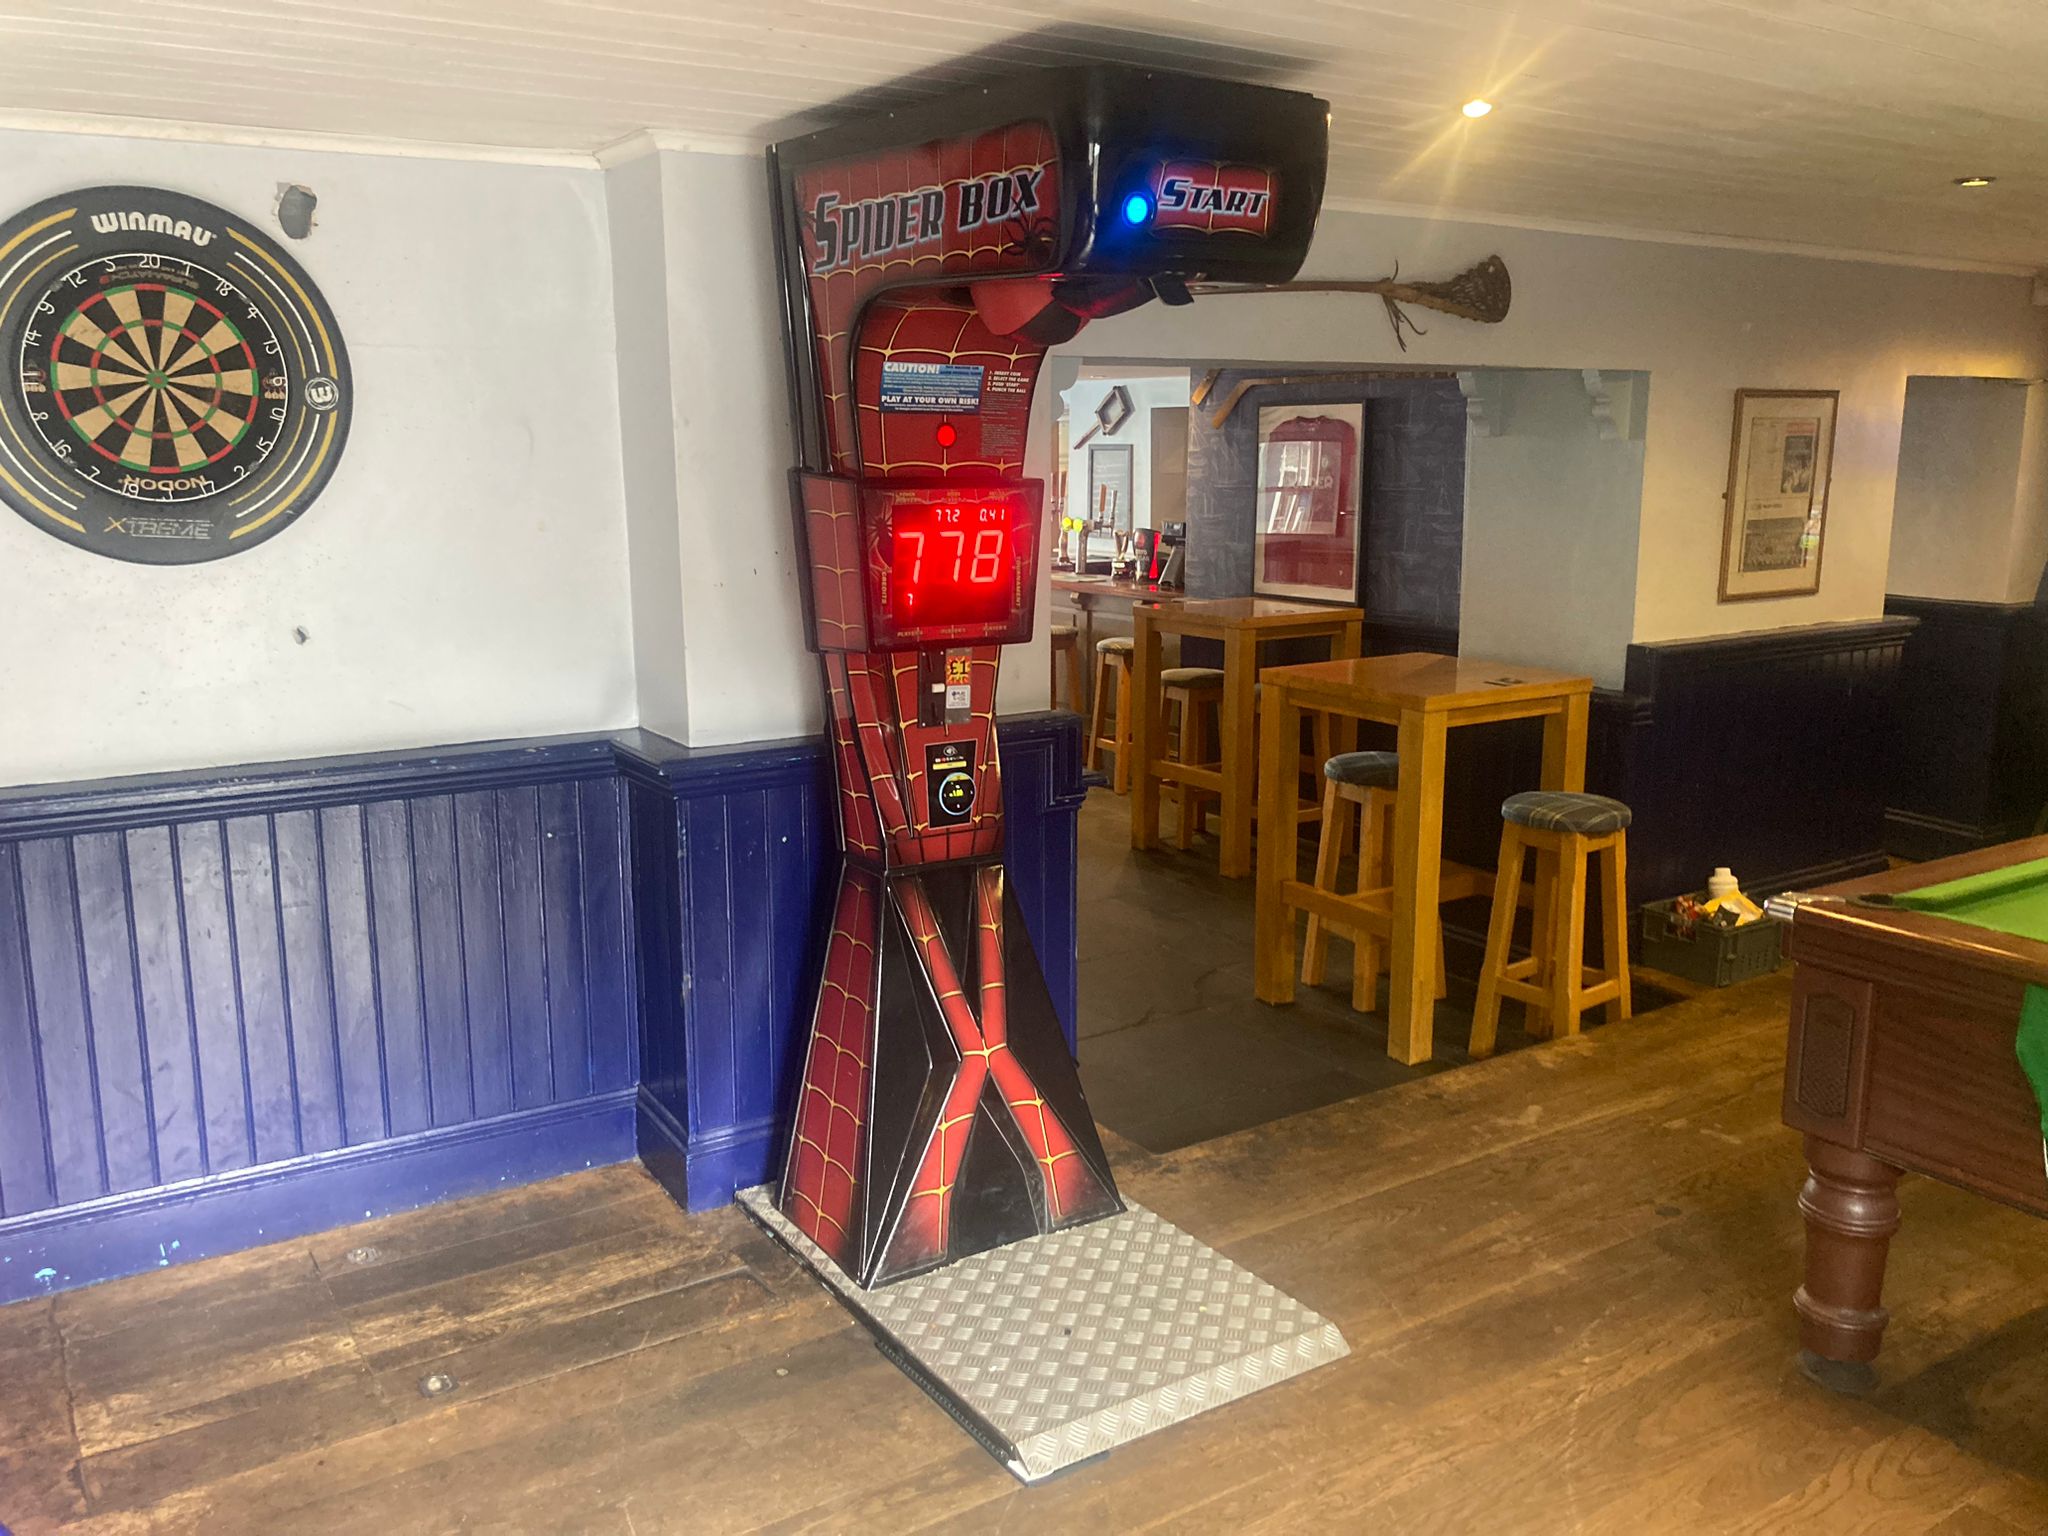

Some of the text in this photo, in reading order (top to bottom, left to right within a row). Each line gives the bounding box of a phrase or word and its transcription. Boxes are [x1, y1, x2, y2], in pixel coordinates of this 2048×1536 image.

[1160, 177, 1270, 216] START
[813, 165, 1045, 273] SPIDER BOX
[90, 211, 213, 247] WINMAU
[138, 254, 160, 269] 20
[65, 270, 88, 289] 12
[216, 278, 233, 296] 18
[884, 362, 940, 374] CAUTION!
[881, 395, 901, 404] PLAY
[902, 396, 912, 404] AT
[914, 397, 937, 405] YOUR
[958, 398, 980, 406] RISK!
[123, 474, 209, 492] NODOR
[899, 529, 1004, 585] 778
[950, 660, 968, 675] £1
